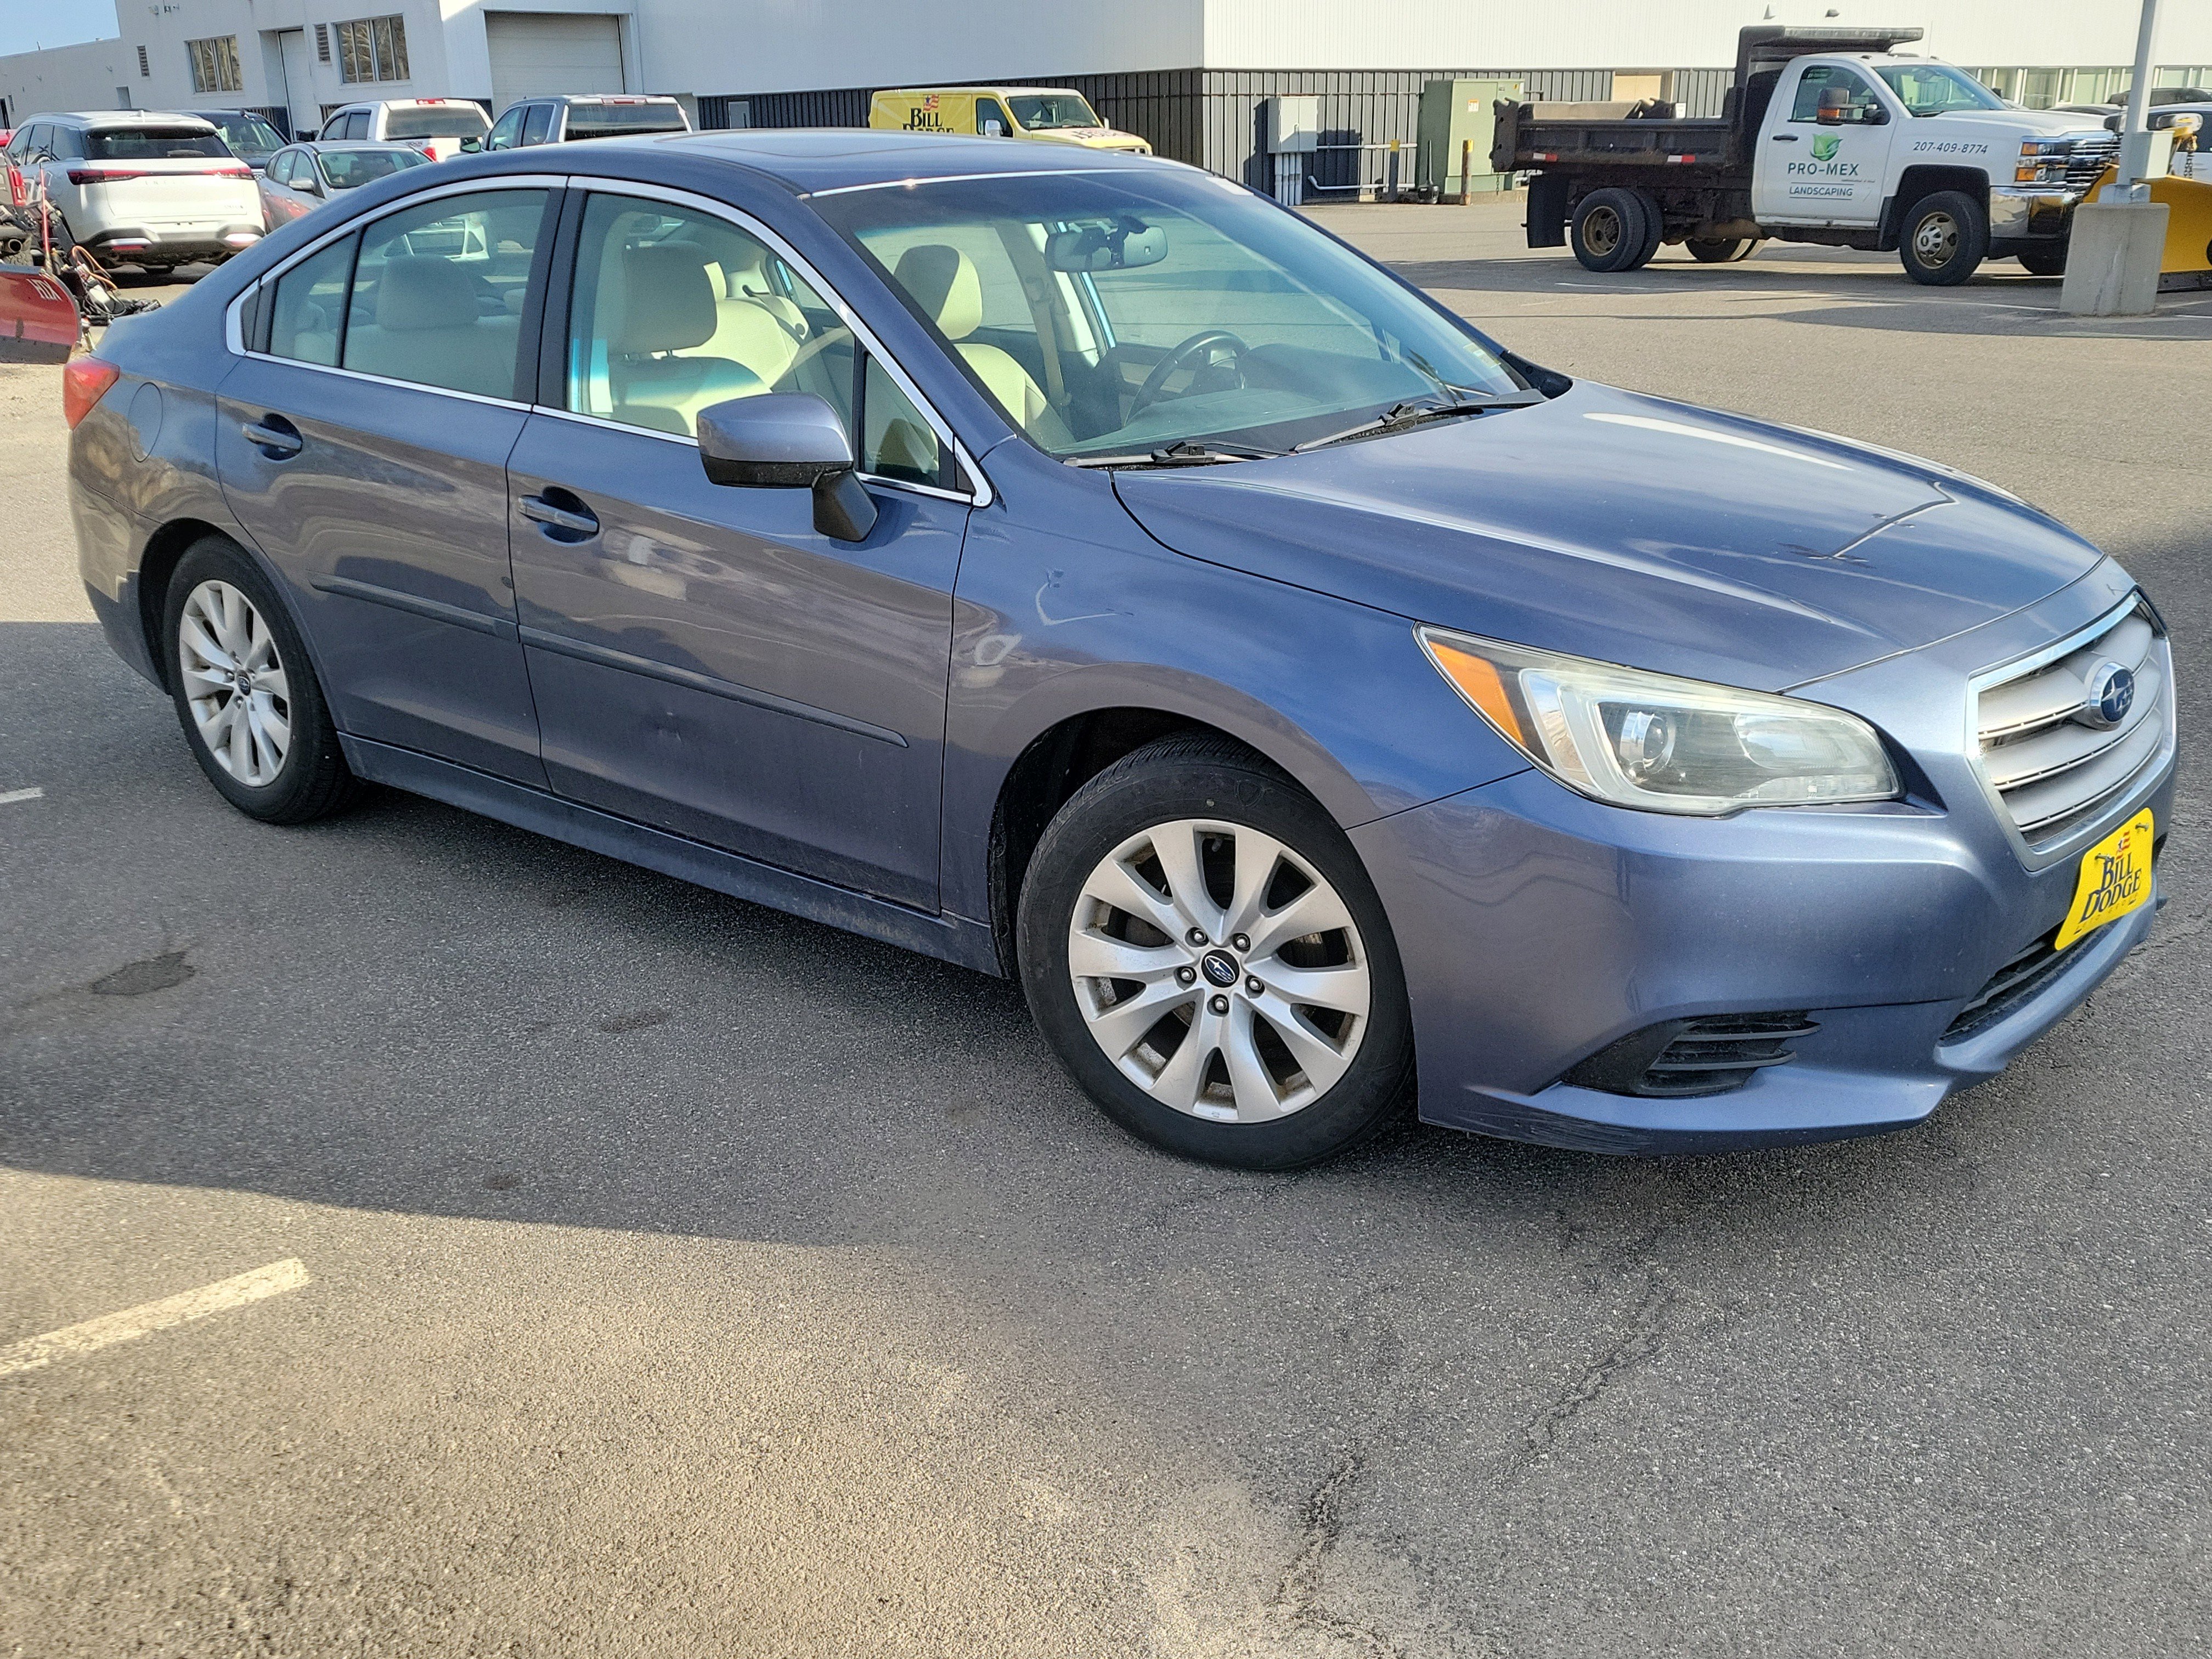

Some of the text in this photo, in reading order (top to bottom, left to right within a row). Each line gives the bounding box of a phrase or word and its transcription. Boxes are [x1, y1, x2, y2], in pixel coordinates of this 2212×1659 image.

[911, 108, 943, 127] BILL
[1913, 142, 1989, 154] 207-409-8774
[1788, 163, 1859, 176] PRO-MEX
[1790, 187, 1853, 196] LANDSCAPING
[25, 279, 63, 301] HTX
[2101, 852, 2134, 892] BILL
[2079, 868, 2142, 924] DODGE
